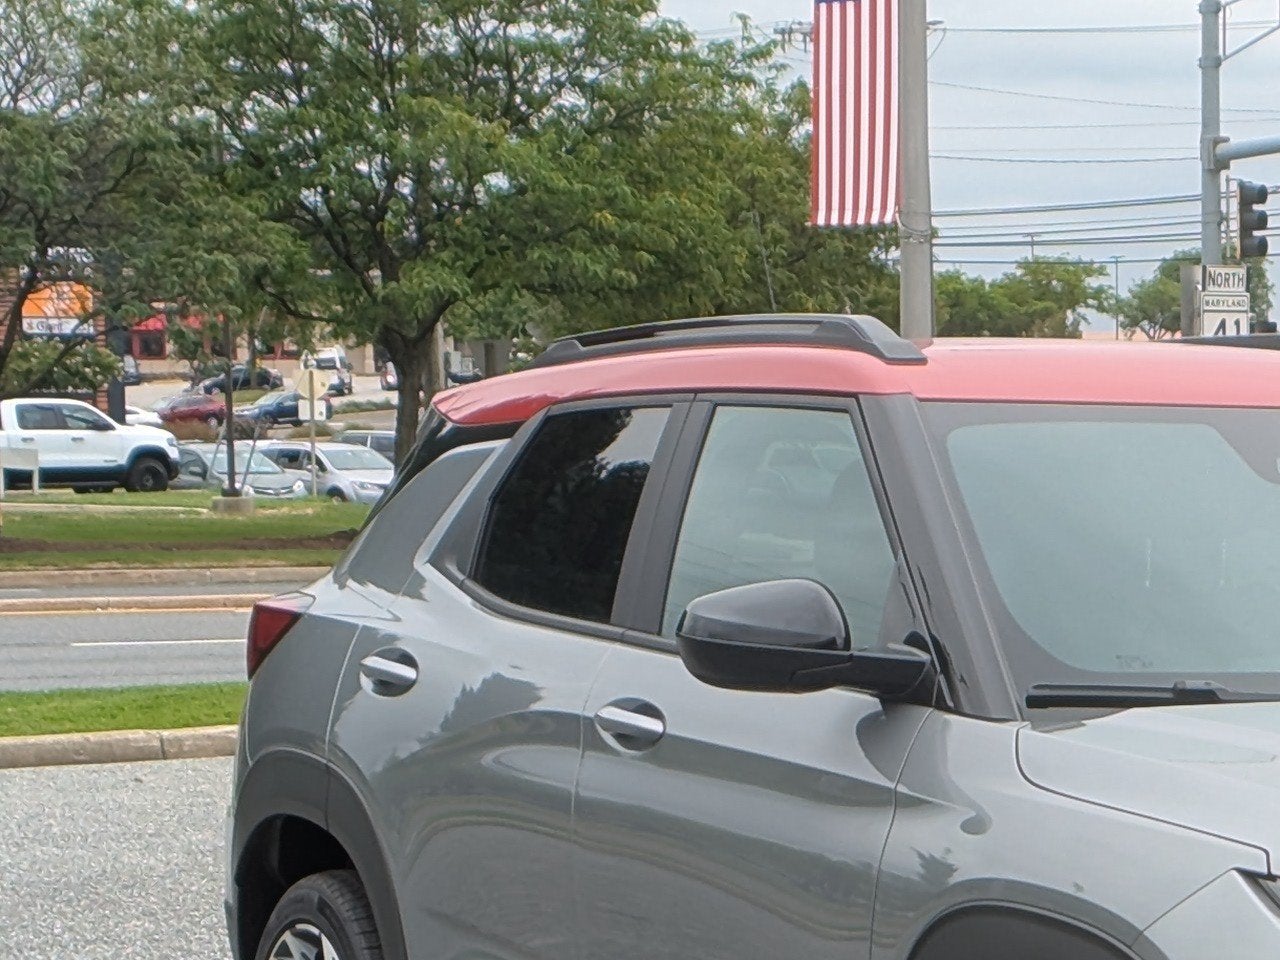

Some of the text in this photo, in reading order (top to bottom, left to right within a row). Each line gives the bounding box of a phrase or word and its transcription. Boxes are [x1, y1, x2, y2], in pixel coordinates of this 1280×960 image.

[1208, 270, 1244, 288] NORTH
[1204, 298, 1247, 307] MARYLAND
[1213, 317, 1241, 336] 41
